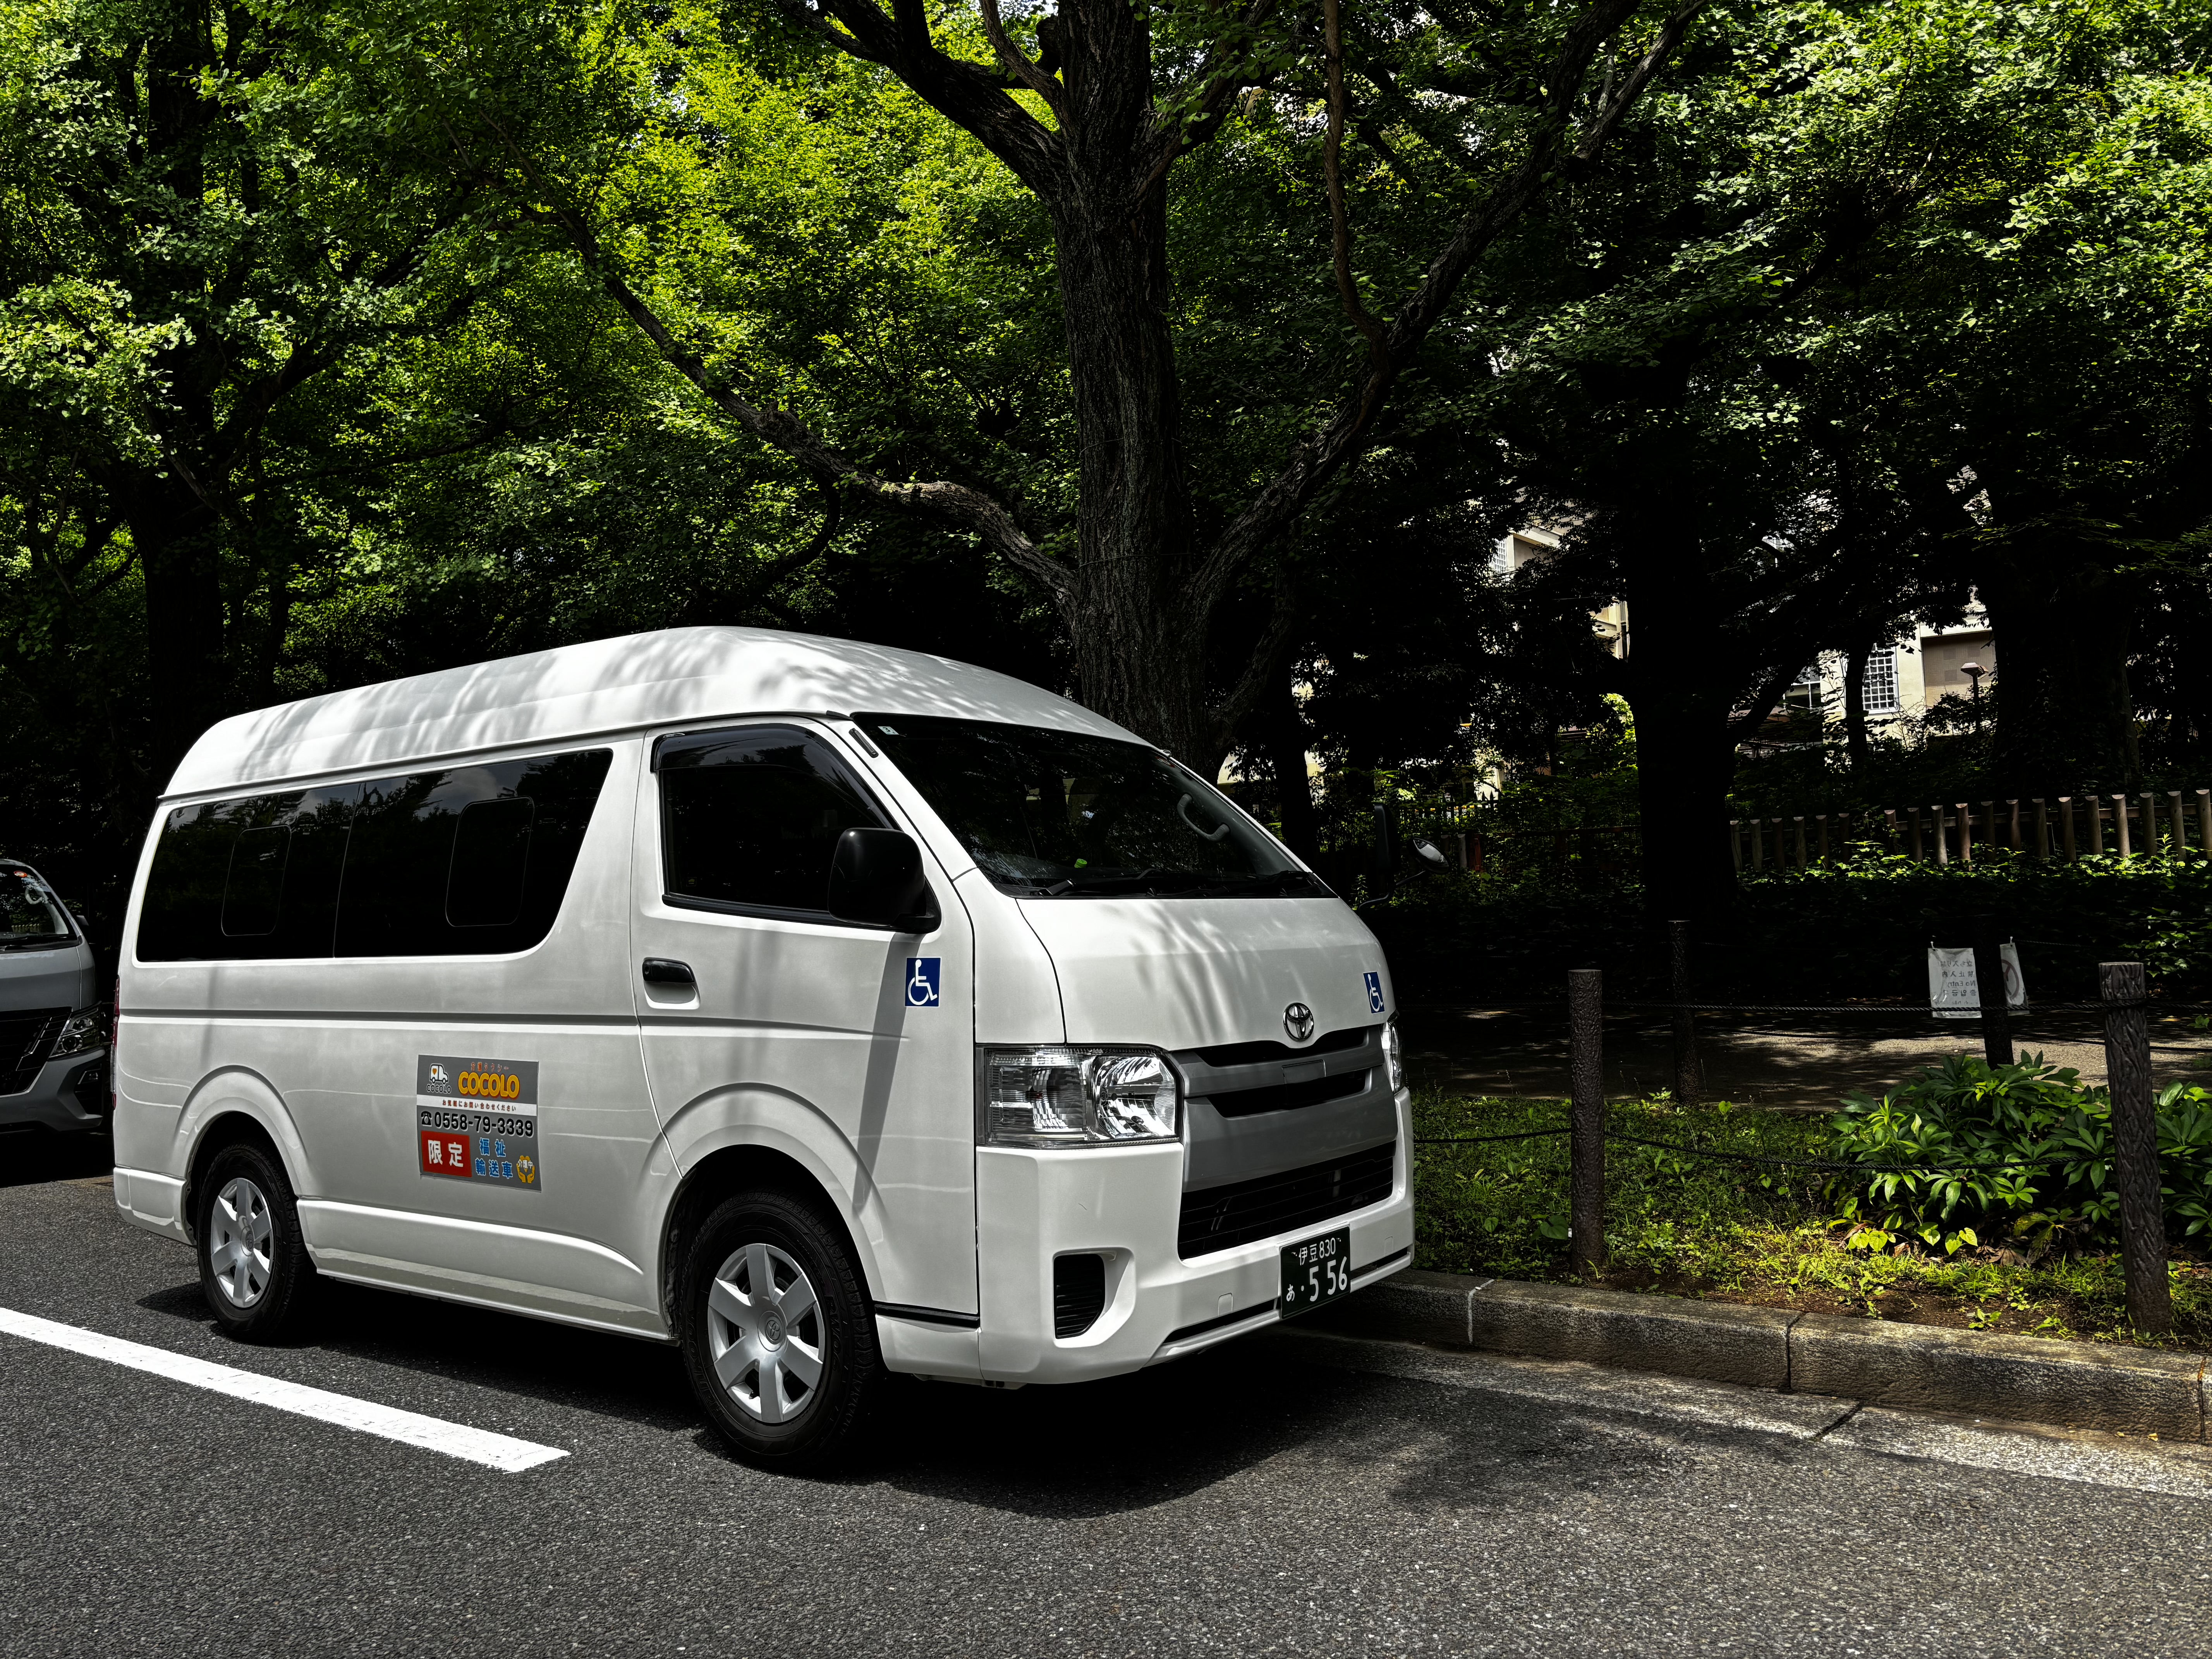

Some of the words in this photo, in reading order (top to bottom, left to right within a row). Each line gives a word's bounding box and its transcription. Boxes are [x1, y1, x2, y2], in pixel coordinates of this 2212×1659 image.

[426, 1084, 451, 1094] COCOLO
[458, 1071, 520, 1098] COCOLO
[442, 1099, 516, 1111] お気軽にお問い合わせください
[434, 1111, 534, 1137] 0558-79-3339
[428, 1139, 464, 1167] 限定
[479, 1137, 506, 1157] 福祉
[475, 1158, 513, 1179] 輸送車
[1286, 1284, 1295, 1302] あ
[687, 1308, 725, 1419] Hankook
